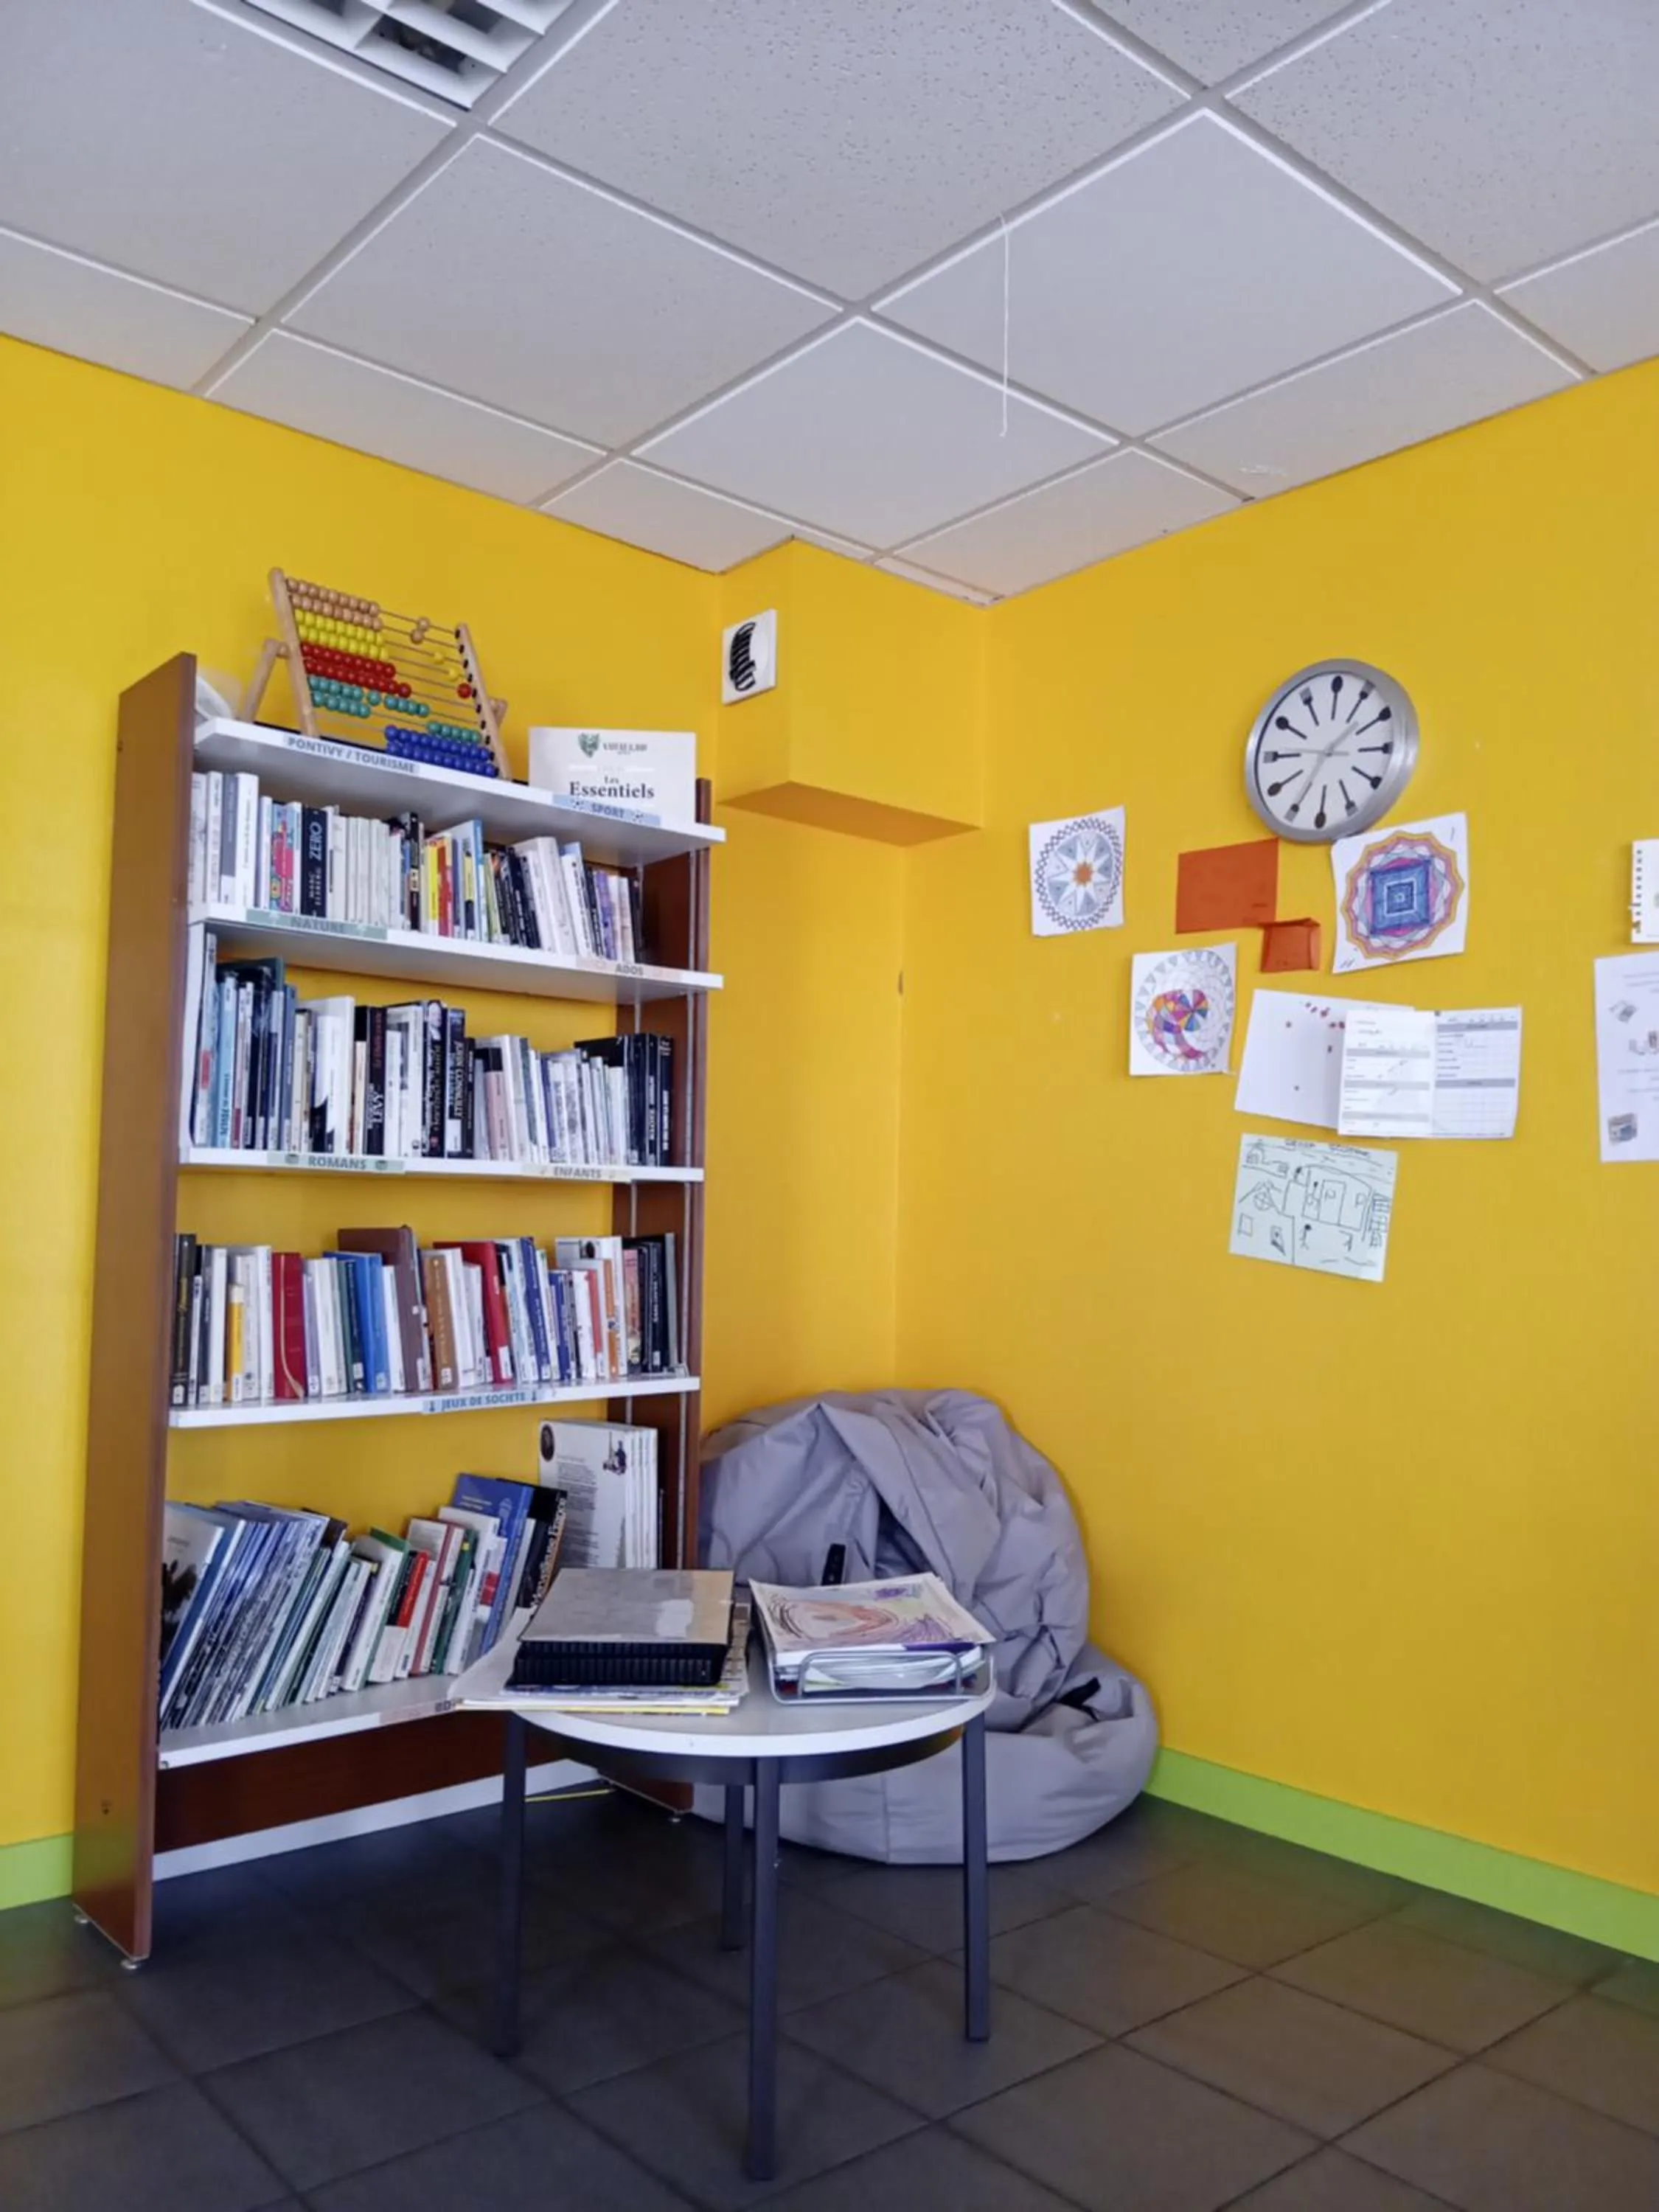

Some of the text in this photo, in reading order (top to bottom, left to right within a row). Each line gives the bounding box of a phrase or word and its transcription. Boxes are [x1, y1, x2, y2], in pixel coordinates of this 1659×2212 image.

[287, 737, 343, 757] PONTIVY
[355, 751, 416, 773] TOURISME
[569, 781, 655, 799] Essentiels
[591, 802, 625, 818] SPORT
[309, 822, 322, 860] ZERO
[615, 963, 644, 975] ADOS
[308, 1155, 366, 1170] ROMANS
[554, 1166, 602, 1178] ENFANTS
[441, 1398, 467, 1411] JEUX
[470, 1396, 481, 1406] DE
